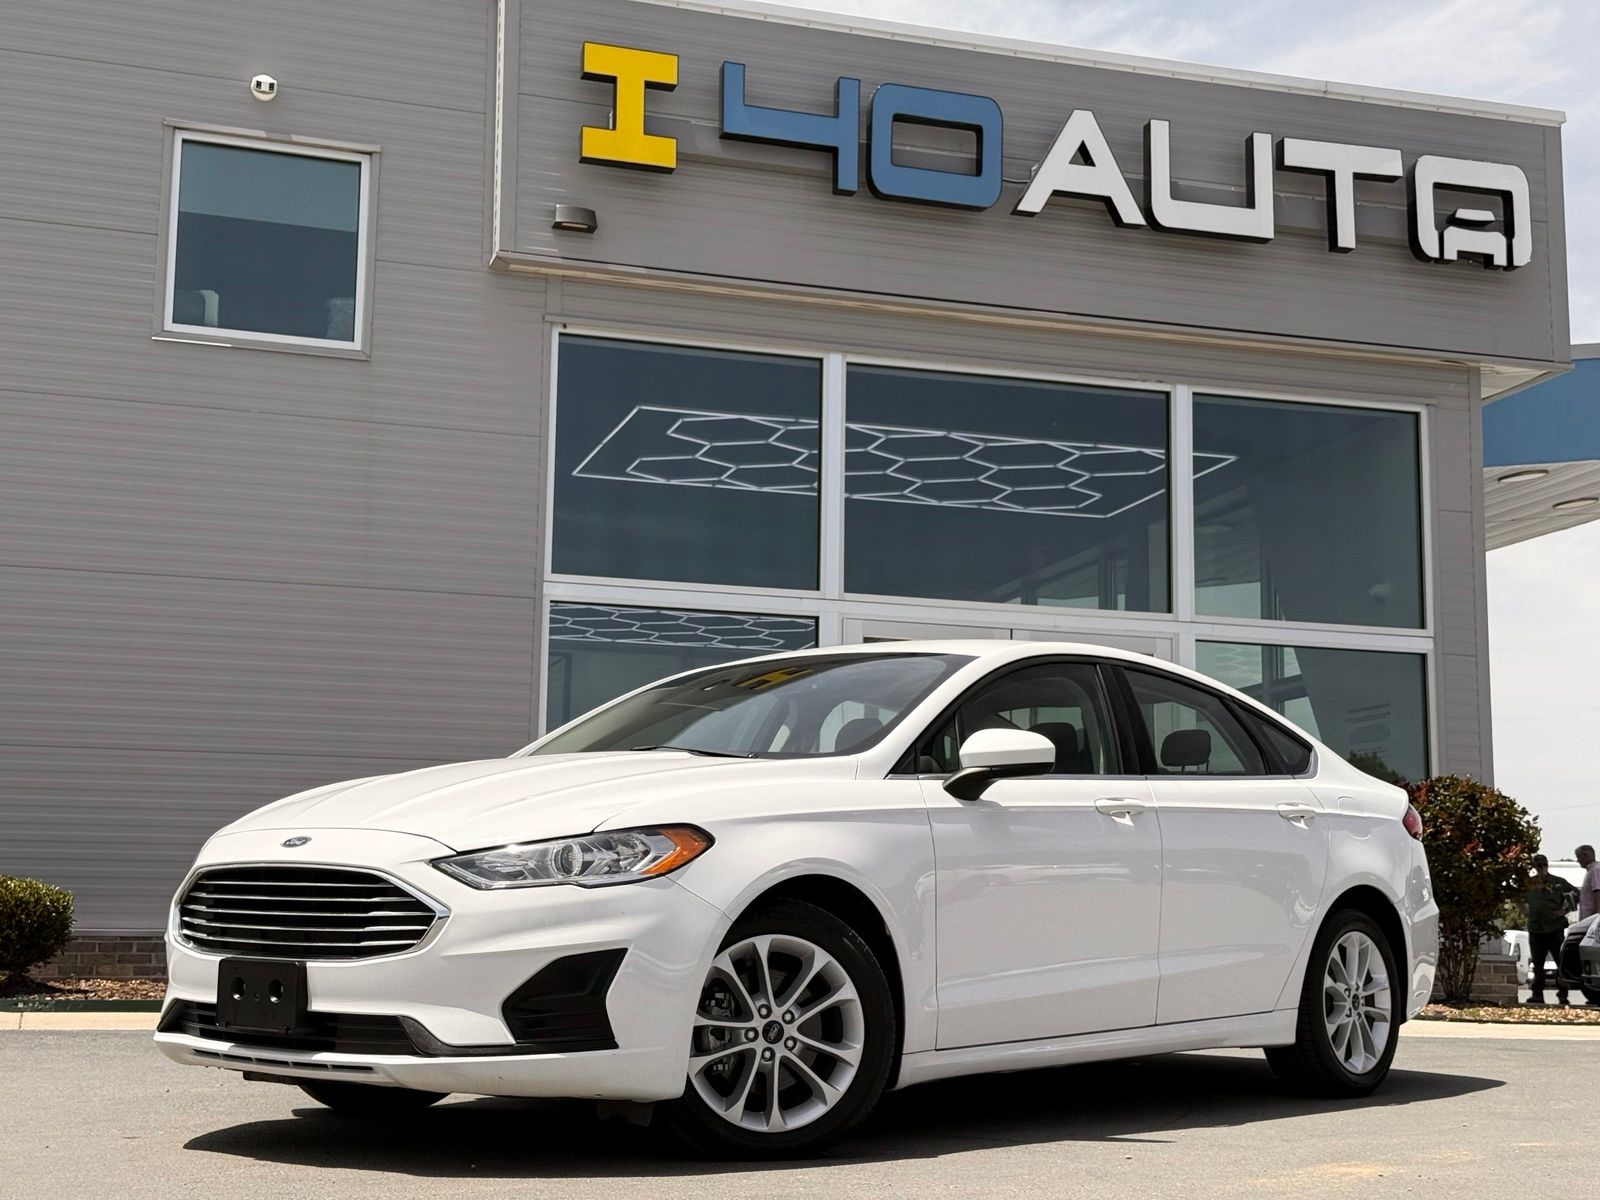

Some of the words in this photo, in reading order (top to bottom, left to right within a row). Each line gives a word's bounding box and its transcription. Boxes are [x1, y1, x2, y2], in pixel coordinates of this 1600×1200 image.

[580, 41, 679, 173] I
[719, 61, 1003, 210] 40
[1011, 109, 1532, 271] AUTO
